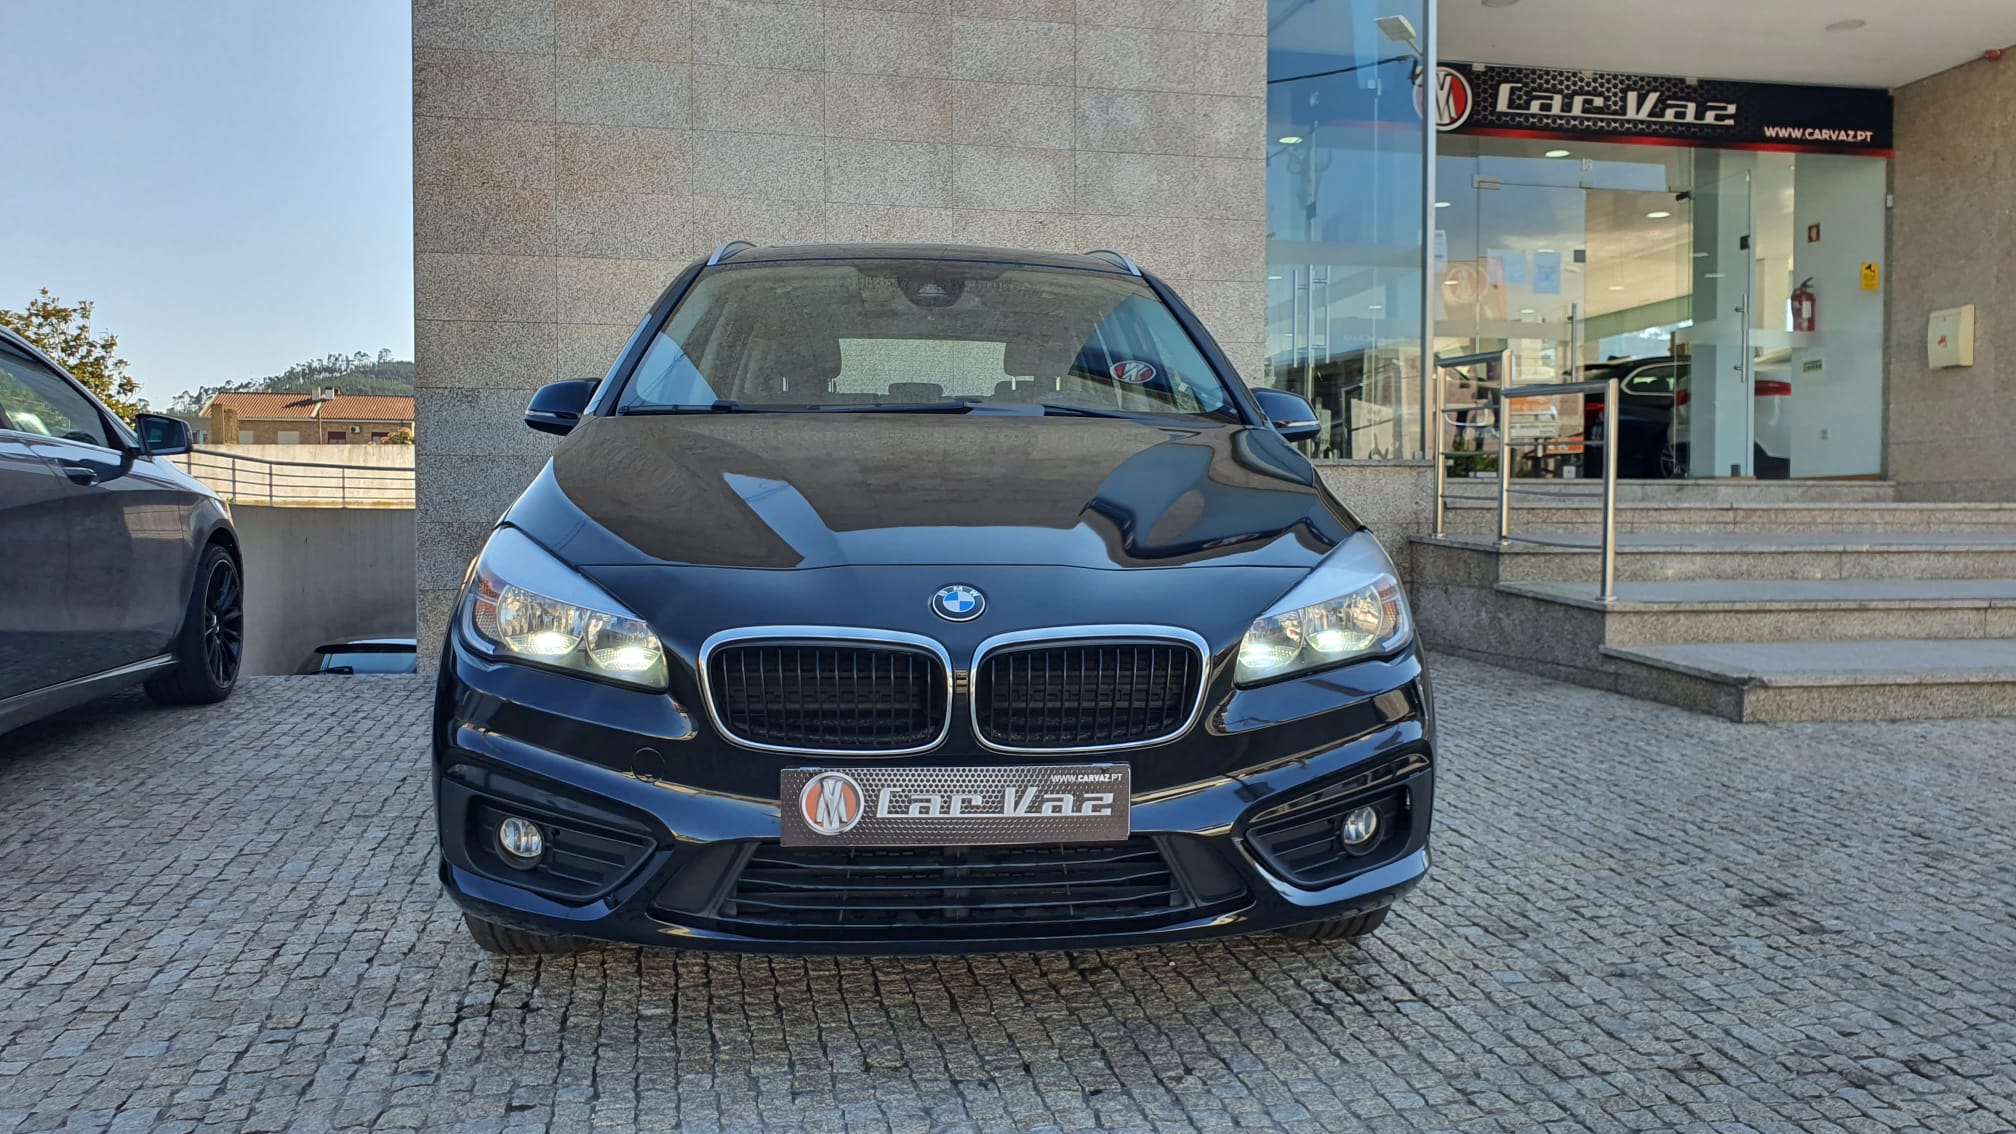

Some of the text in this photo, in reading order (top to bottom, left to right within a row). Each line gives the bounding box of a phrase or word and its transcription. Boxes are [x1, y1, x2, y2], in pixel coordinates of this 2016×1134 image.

[1496, 83, 1603, 117] Car
[1764, 126, 1873, 142] WWW.CARVAZ.PT
[1051, 773, 1123, 783] WWW.CARVAZ.PT
[876, 787, 983, 819] Car
